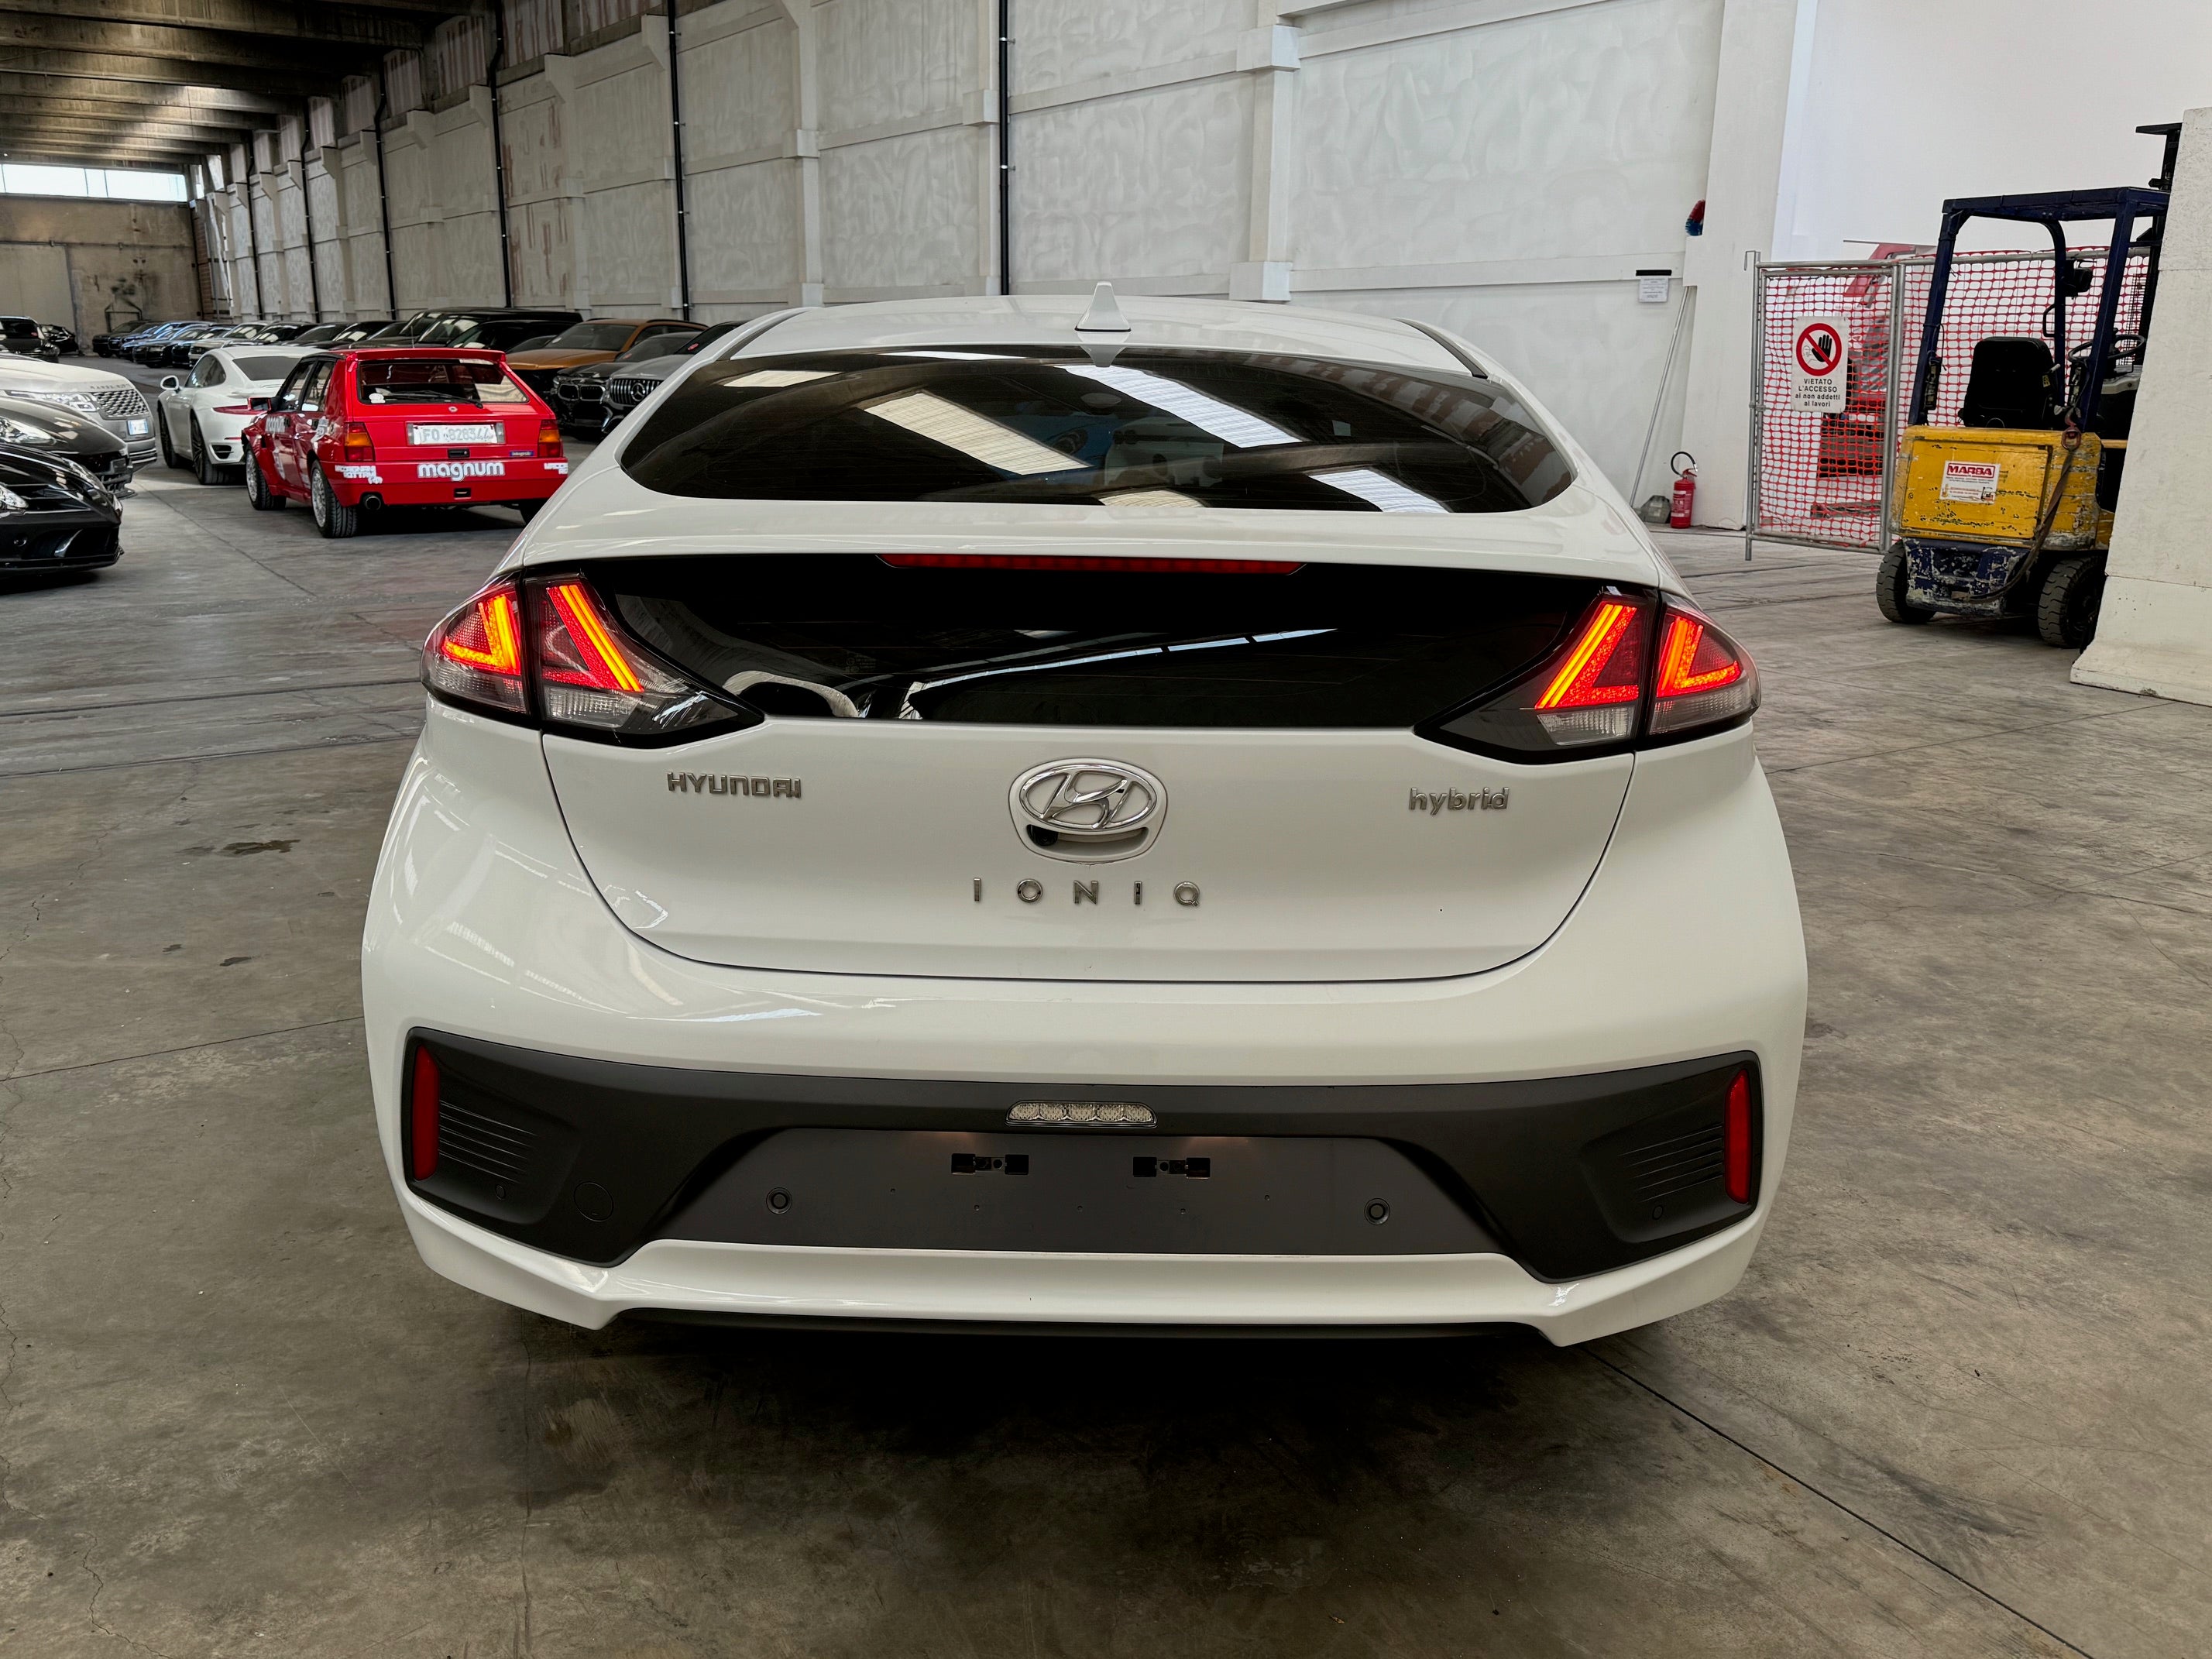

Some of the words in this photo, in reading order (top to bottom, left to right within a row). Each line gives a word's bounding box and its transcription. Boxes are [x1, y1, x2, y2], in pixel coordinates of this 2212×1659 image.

[418, 462, 504, 482] magnum
[667, 771, 802, 798] HYUNDAI
[1409, 787, 1510, 816] hybrid
[974, 878, 1200, 907] IONIQ
